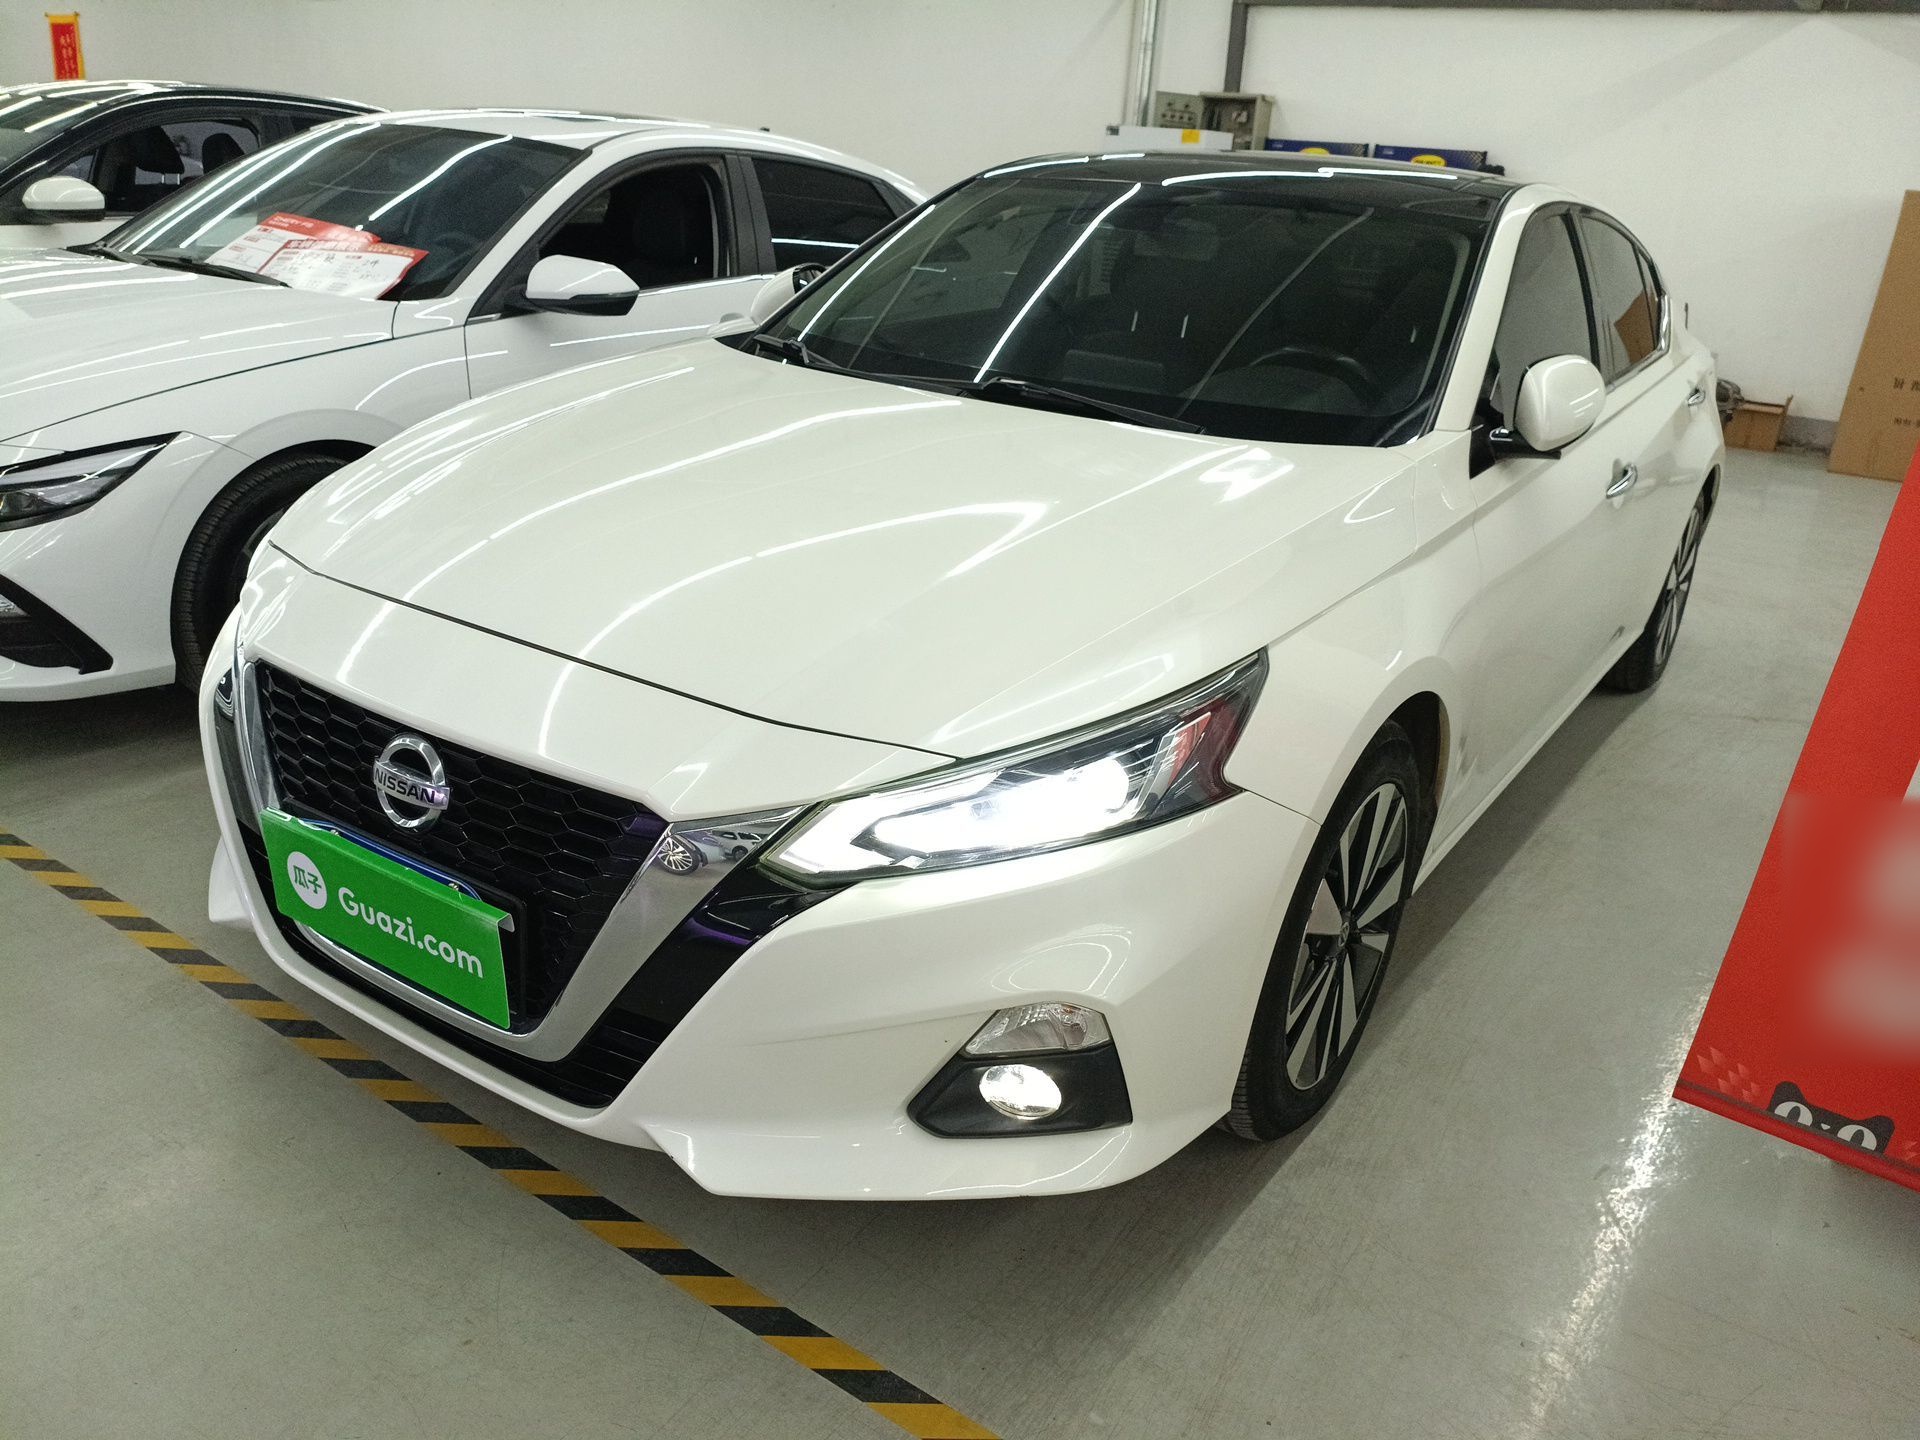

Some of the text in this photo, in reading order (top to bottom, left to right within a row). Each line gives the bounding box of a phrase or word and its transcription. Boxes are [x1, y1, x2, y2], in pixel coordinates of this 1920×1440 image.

[374, 767, 436, 804] NISSAN
[292, 865, 322, 895] 瓜子
[338, 886, 484, 979] Guazi.com
